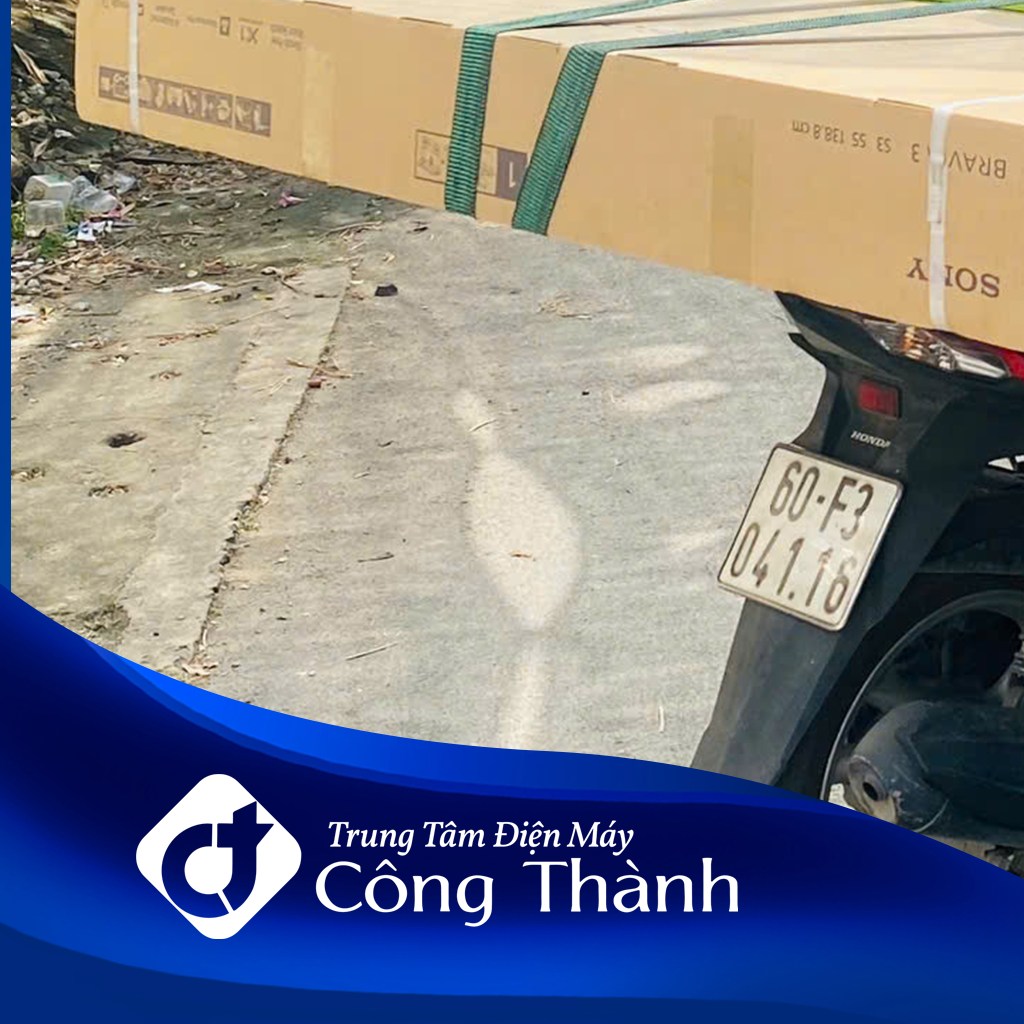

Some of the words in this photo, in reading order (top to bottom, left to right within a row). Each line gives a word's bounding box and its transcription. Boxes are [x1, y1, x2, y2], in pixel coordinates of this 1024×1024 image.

[791, 120, 810, 134] cm
[812, 122, 845, 142] 138.8
[876, 136, 892, 154] S3
[910, 143, 920, 163] 3
